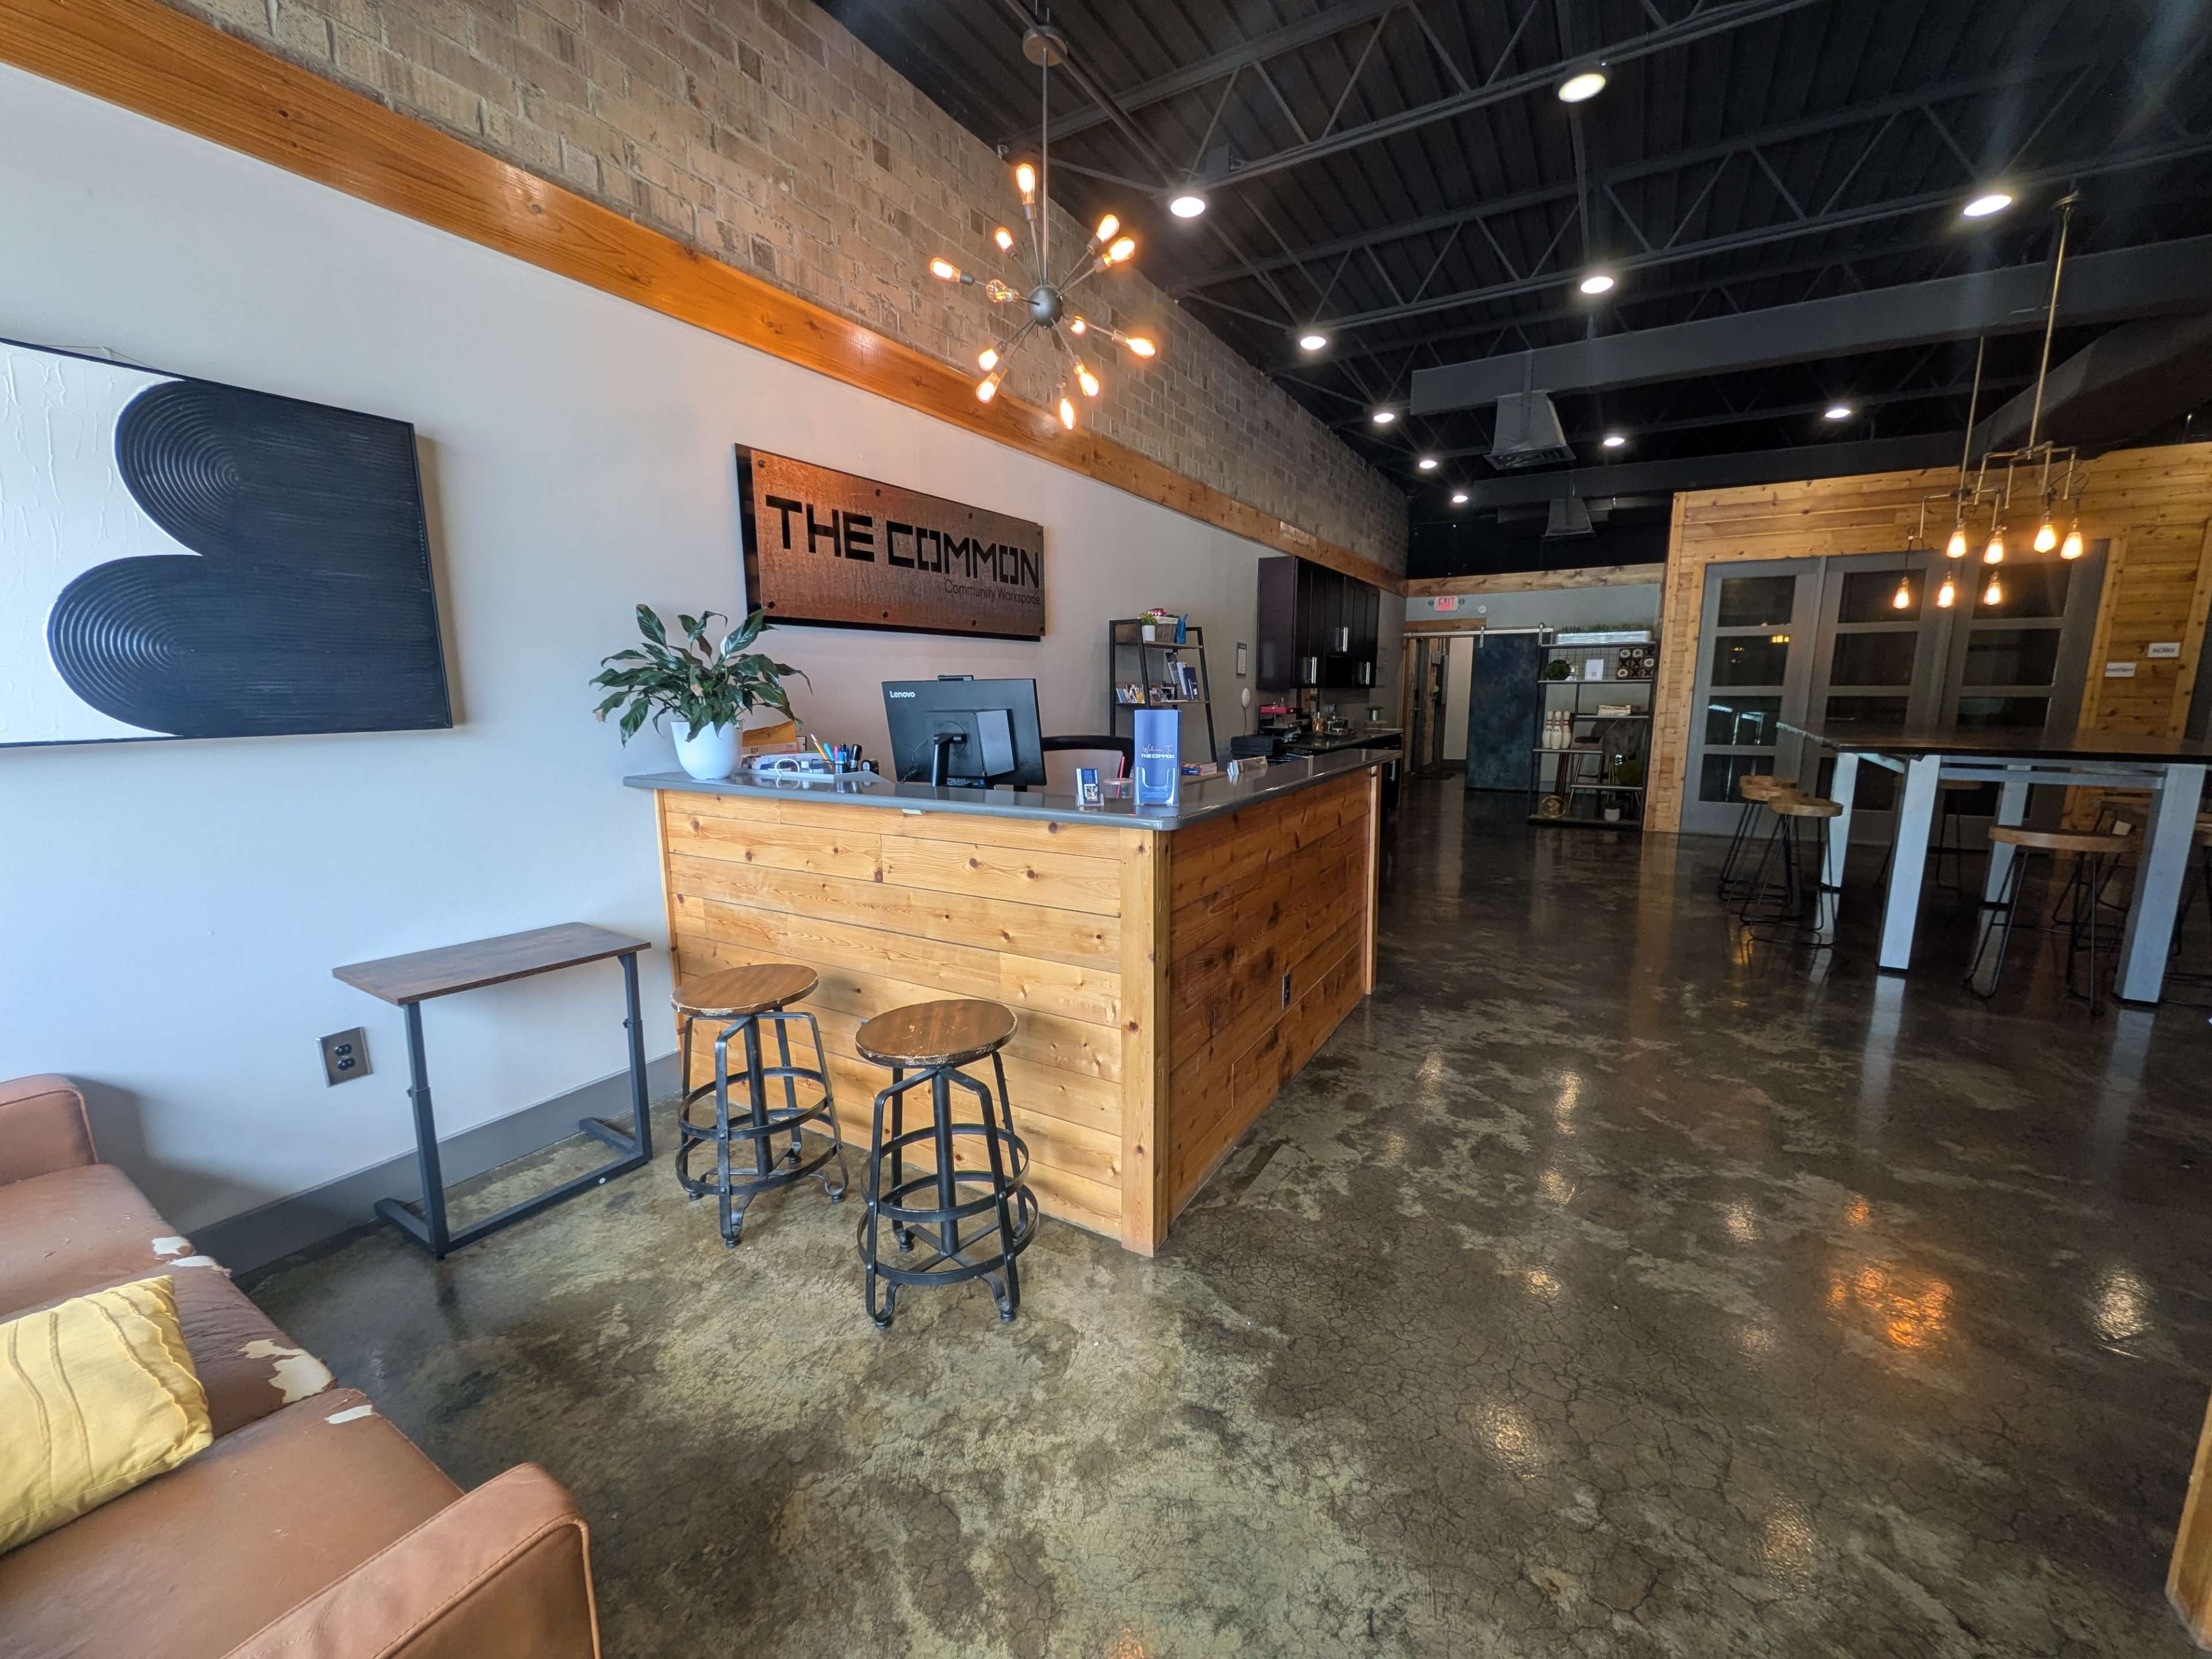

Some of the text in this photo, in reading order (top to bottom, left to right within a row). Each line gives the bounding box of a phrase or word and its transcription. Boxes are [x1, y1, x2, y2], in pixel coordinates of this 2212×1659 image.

[766, 494, 1039, 588] THE COMMON
[945, 579, 1041, 606] Community Workspace
[1438, 597, 1455, 605] EXIT
